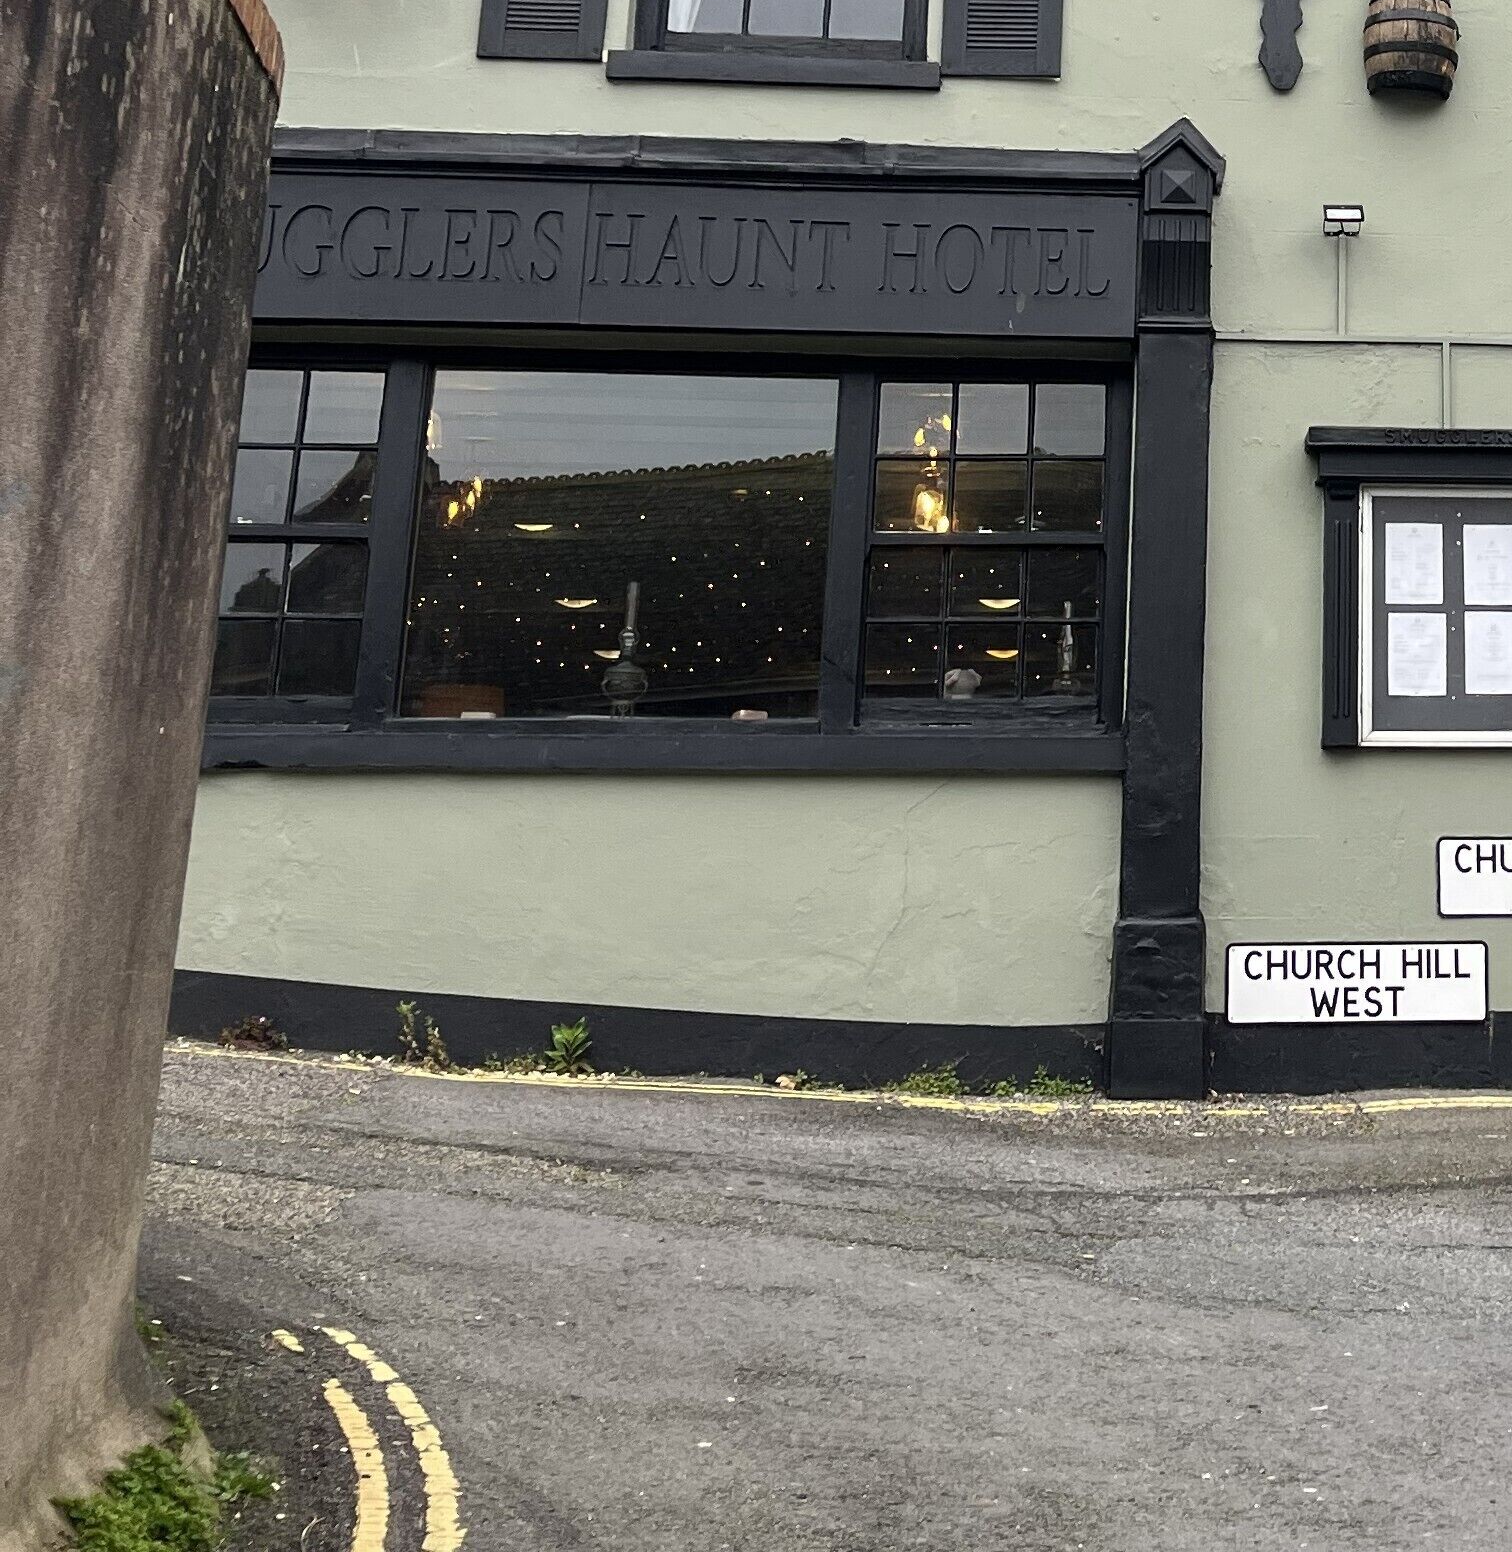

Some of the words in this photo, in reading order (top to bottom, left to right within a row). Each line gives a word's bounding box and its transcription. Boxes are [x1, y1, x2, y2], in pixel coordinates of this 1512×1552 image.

[588, 213, 850, 292] HAUNT
[877, 222, 1110, 298] HOTEL
[1244, 949, 1381, 981] CHURCH
[1401, 948, 1471, 979] HILL
[1311, 986, 1405, 1018] WEST
